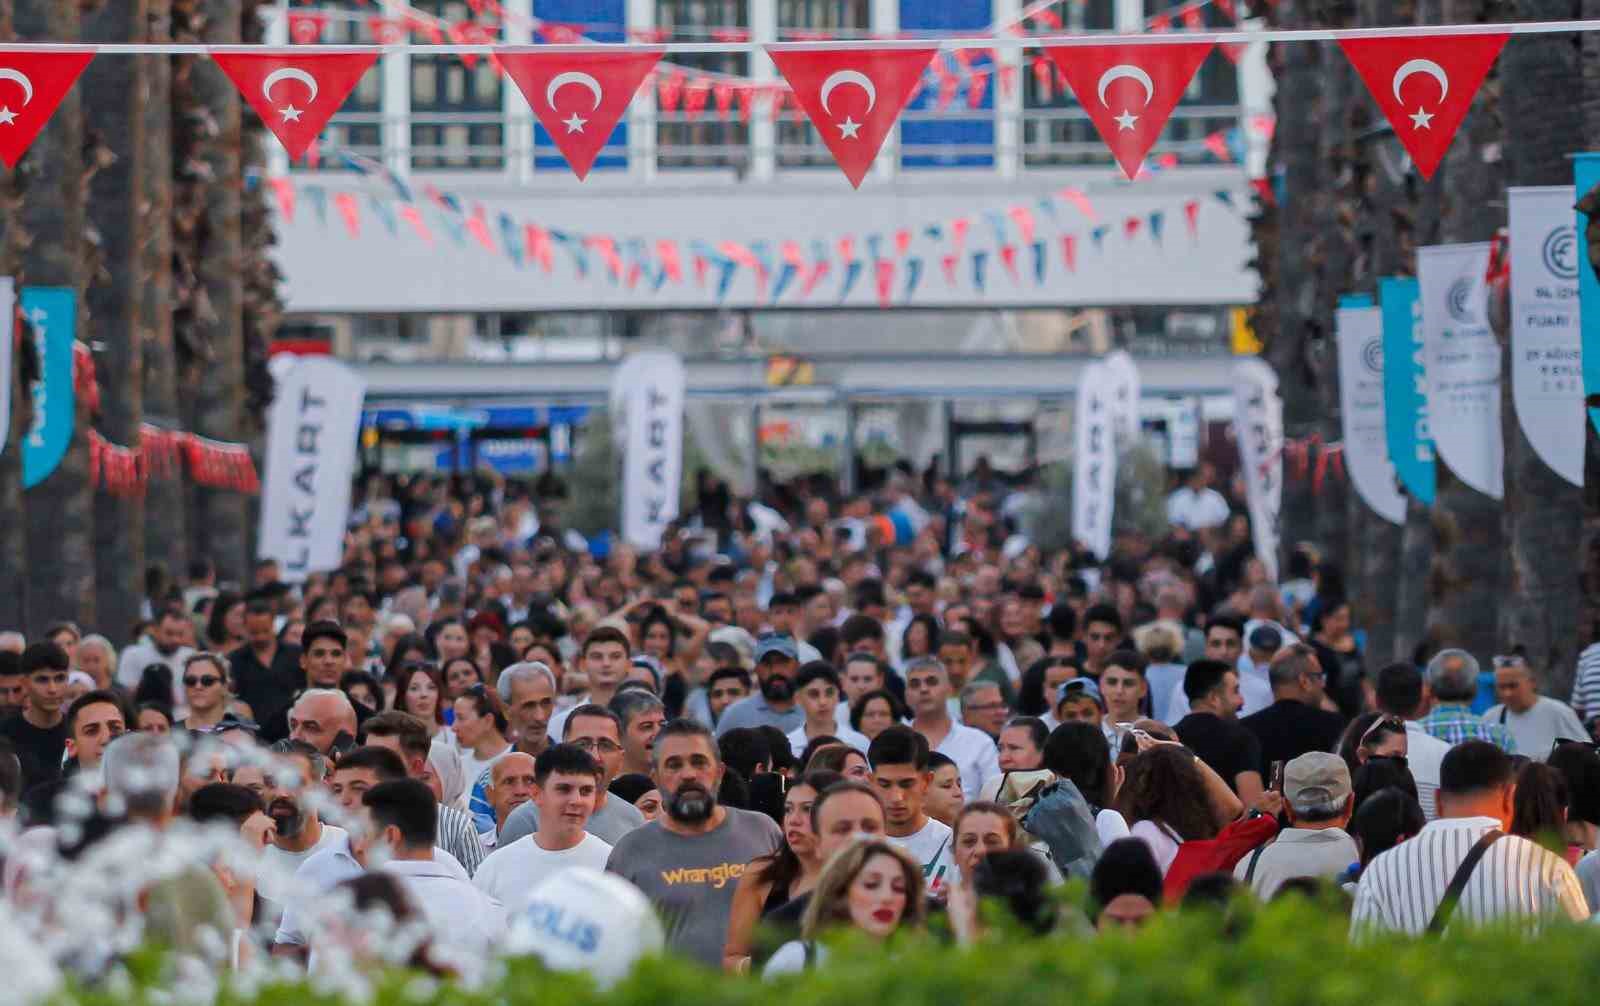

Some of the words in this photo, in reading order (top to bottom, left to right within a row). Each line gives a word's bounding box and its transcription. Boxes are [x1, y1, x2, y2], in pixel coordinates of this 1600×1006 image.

[287, 386, 325, 572] LKART
[644, 384, 668, 522] KART
[1087, 392, 1103, 529] KART
